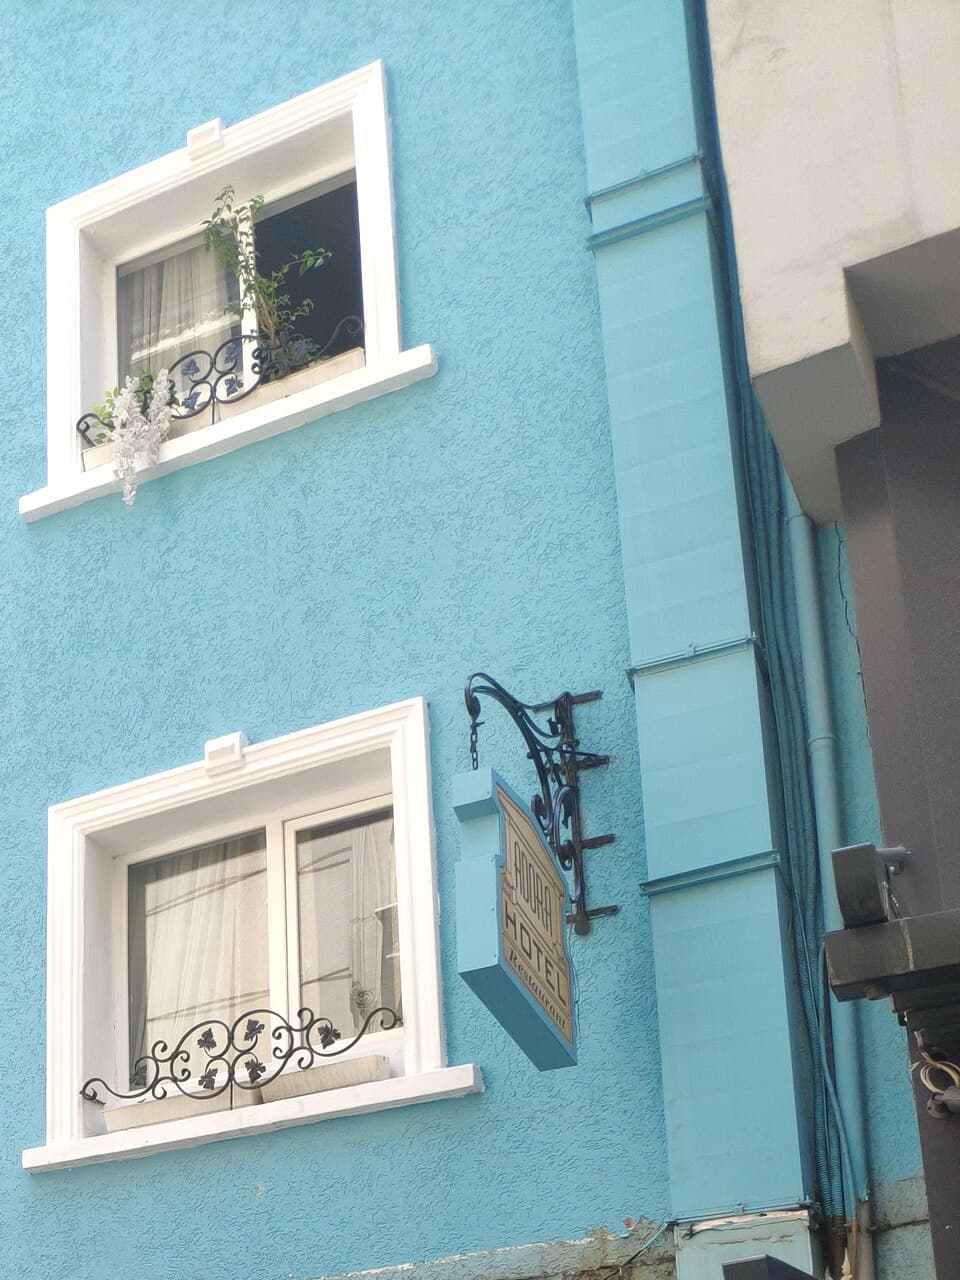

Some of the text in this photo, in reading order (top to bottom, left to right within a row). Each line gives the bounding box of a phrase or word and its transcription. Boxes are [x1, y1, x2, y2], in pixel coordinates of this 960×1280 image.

[513, 840, 553, 938] ADORA
[504, 900, 567, 1007] HOTEL
[508, 949, 566, 1028] Restaurant
